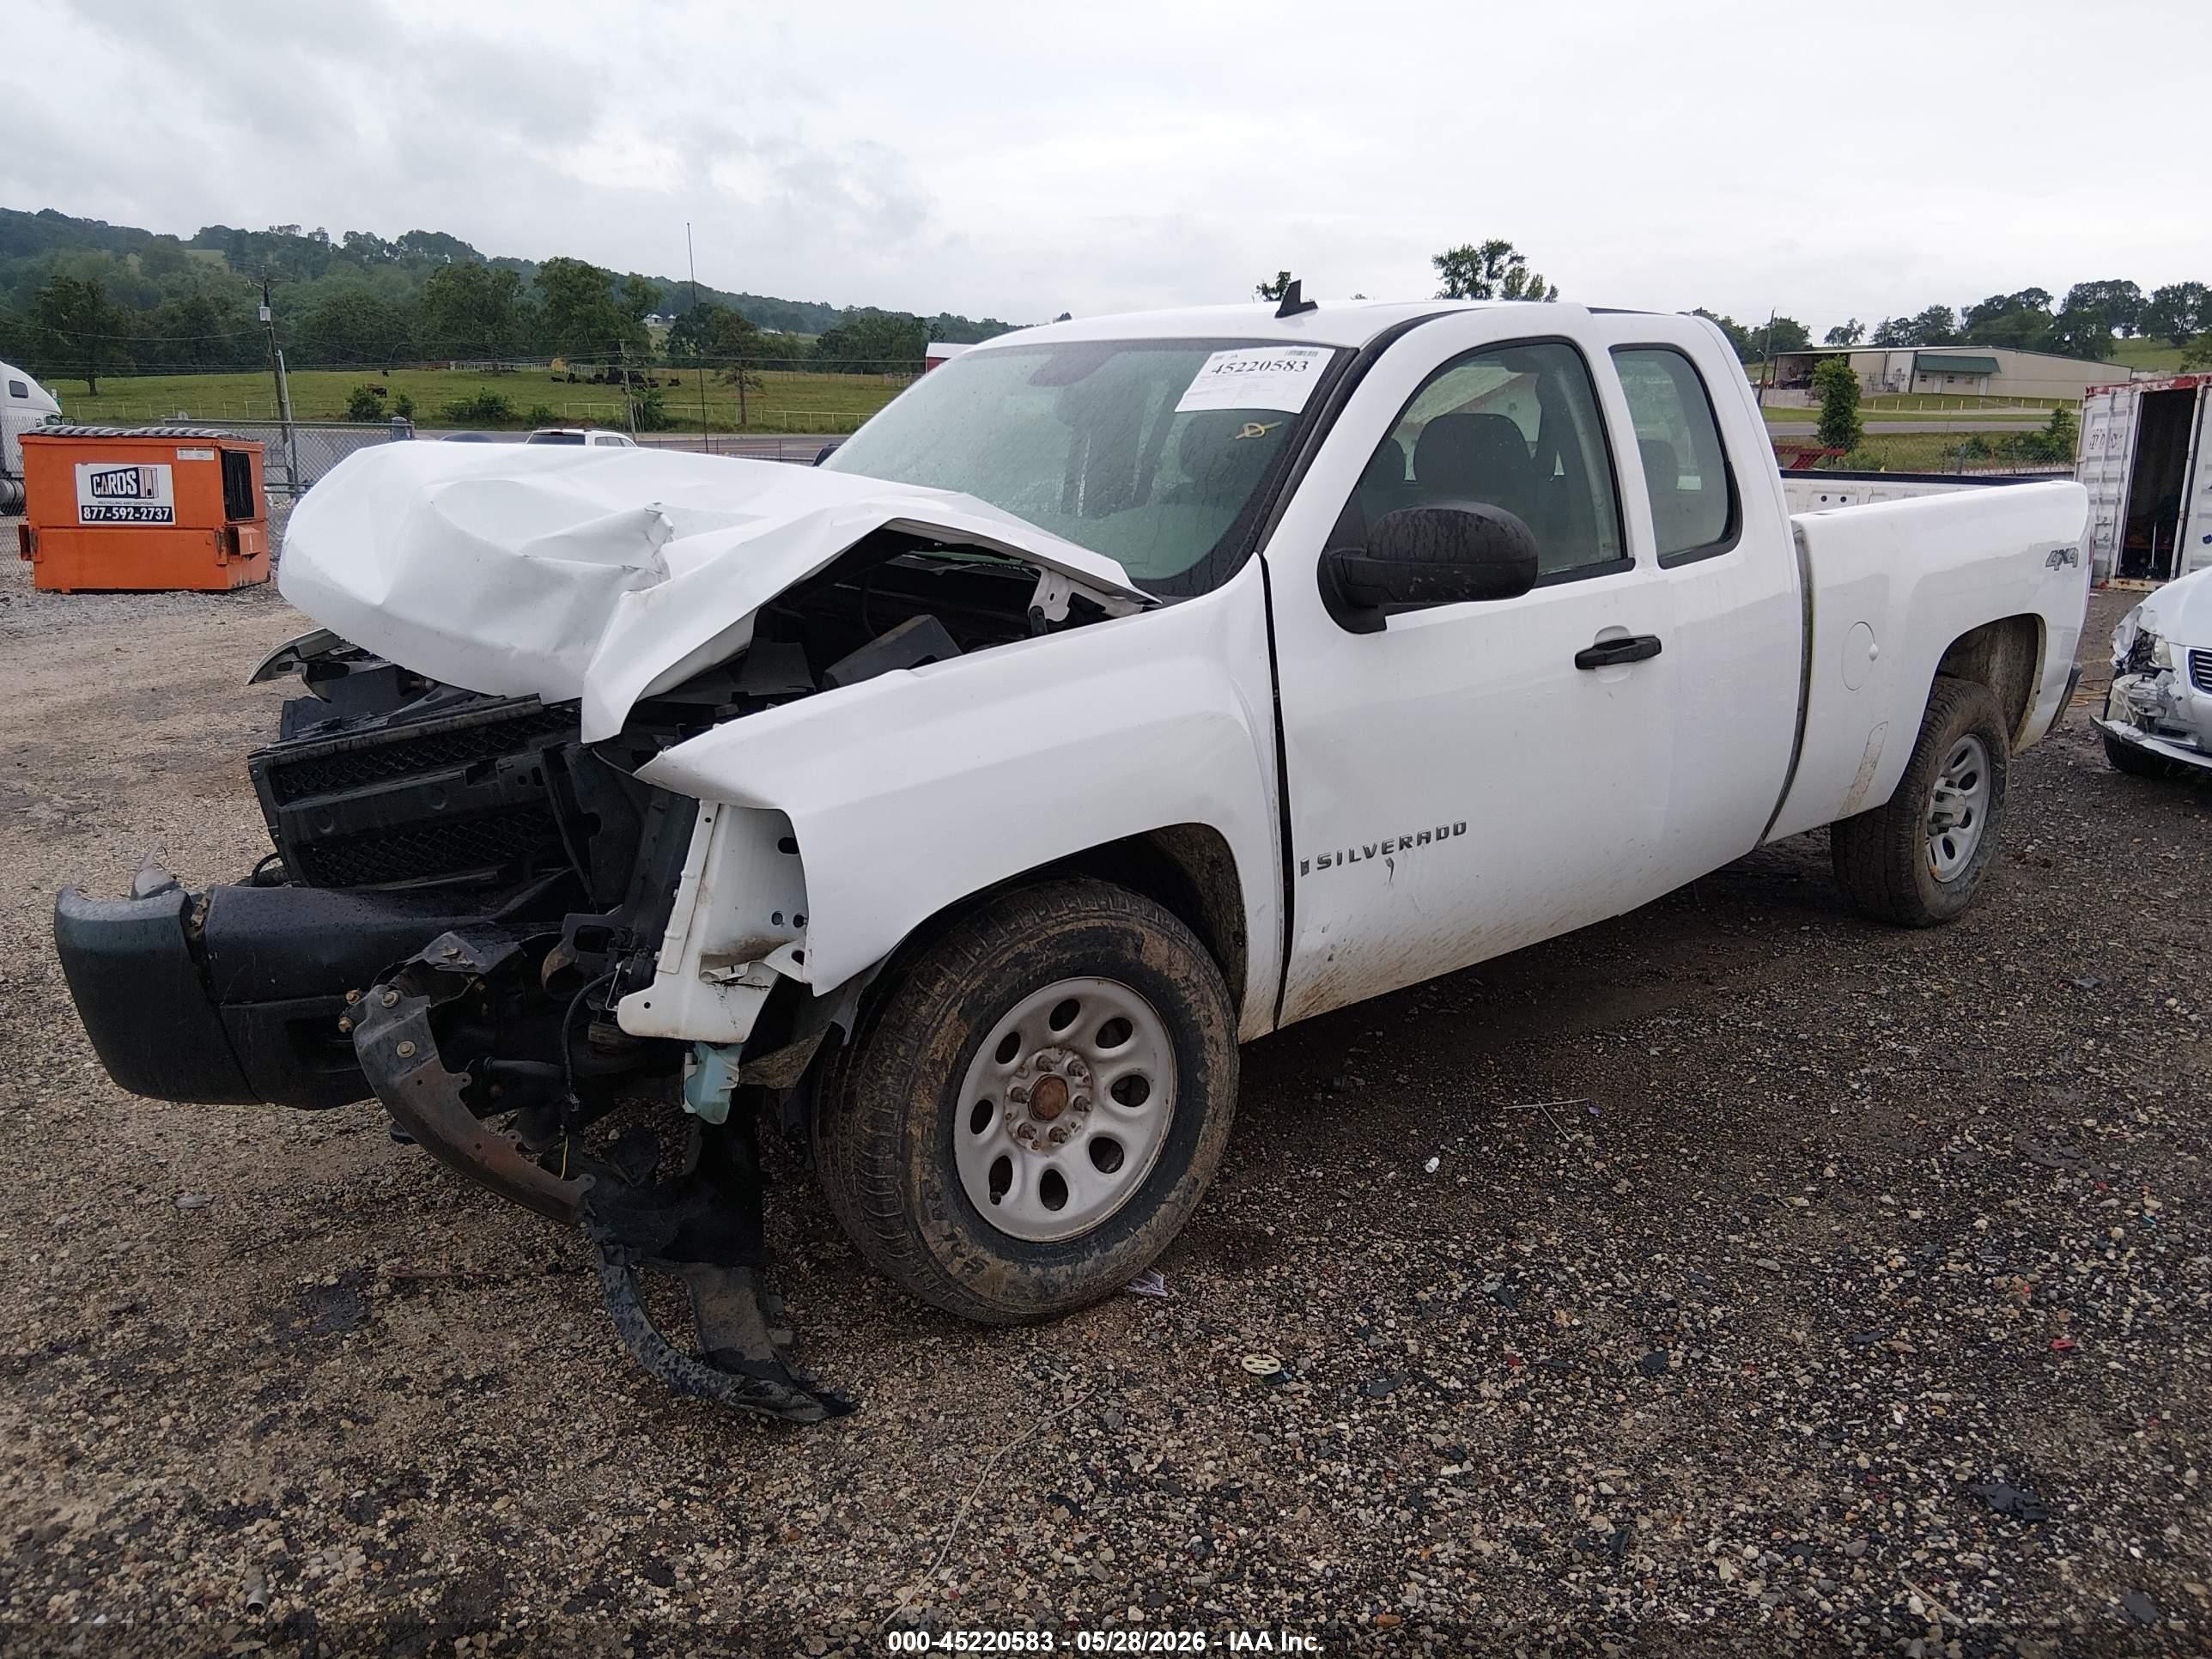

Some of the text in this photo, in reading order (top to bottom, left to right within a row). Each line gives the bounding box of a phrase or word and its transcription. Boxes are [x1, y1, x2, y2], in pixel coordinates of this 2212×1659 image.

[1212, 360, 1309, 374] 45220583
[93, 471, 137, 495] CARDS
[83, 507, 170, 520] 877-592-2737
[1316, 819, 1468, 871] SILVERADO
